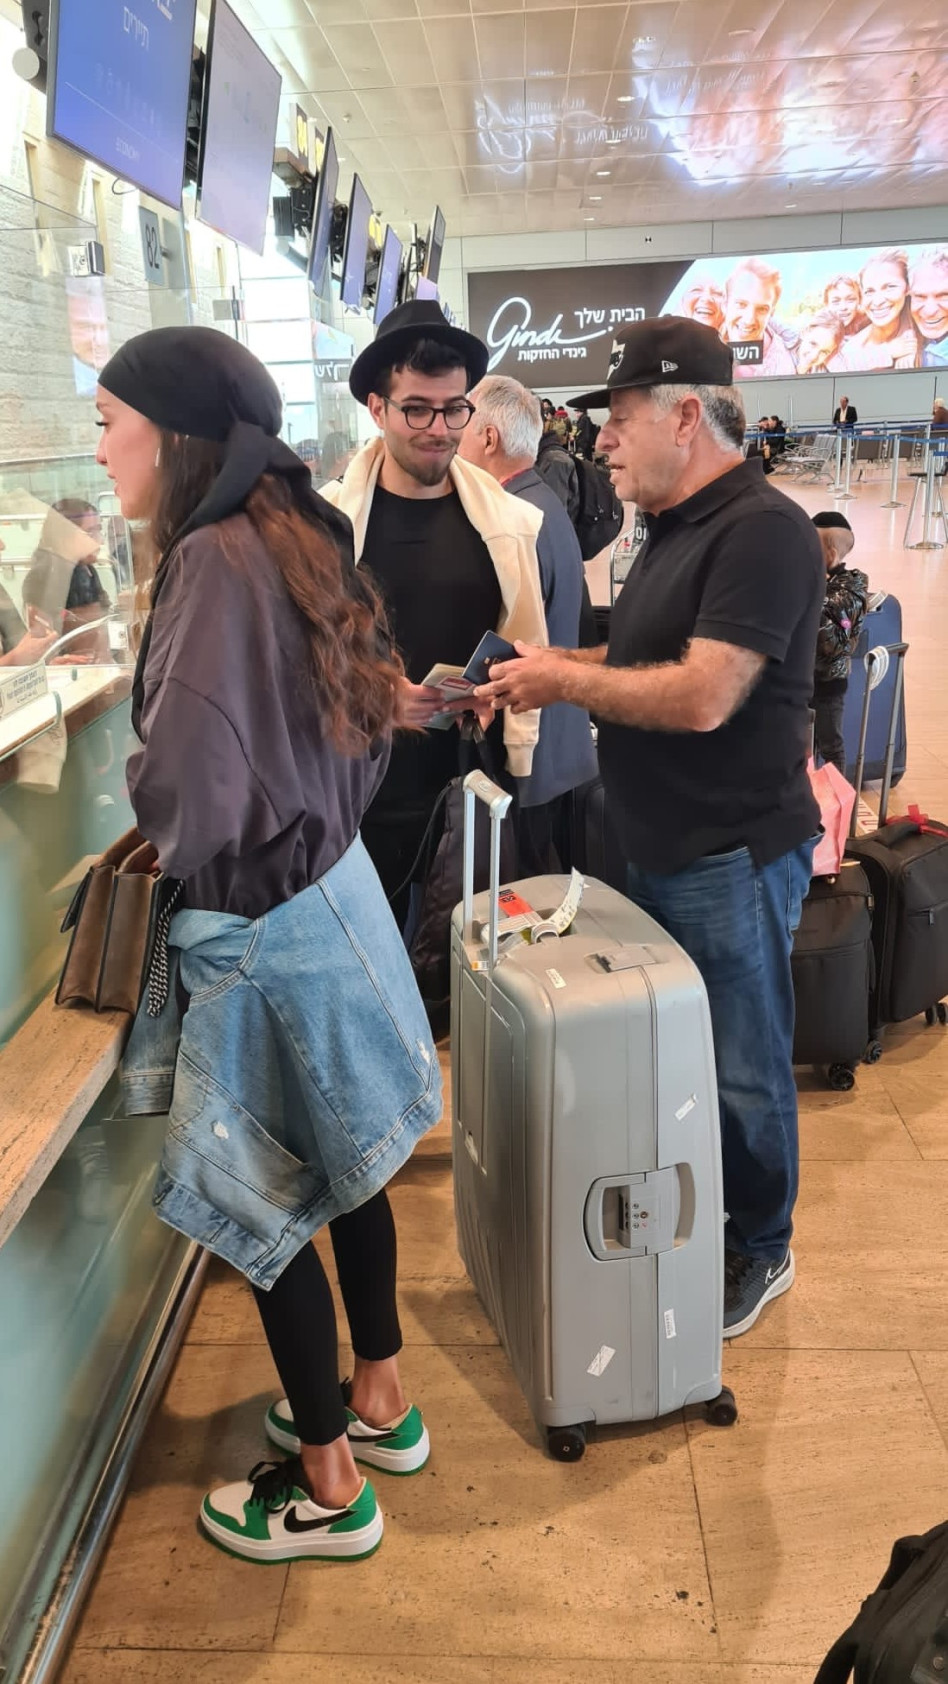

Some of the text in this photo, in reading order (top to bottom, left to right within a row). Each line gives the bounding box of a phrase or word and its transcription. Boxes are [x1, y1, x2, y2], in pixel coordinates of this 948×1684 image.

[123, 6, 149, 50] תיירים
[146, 224, 159, 269] 82
[574, 307, 645, 329] הבית שלך
[517, 347, 587, 363] גינדי החזקות
